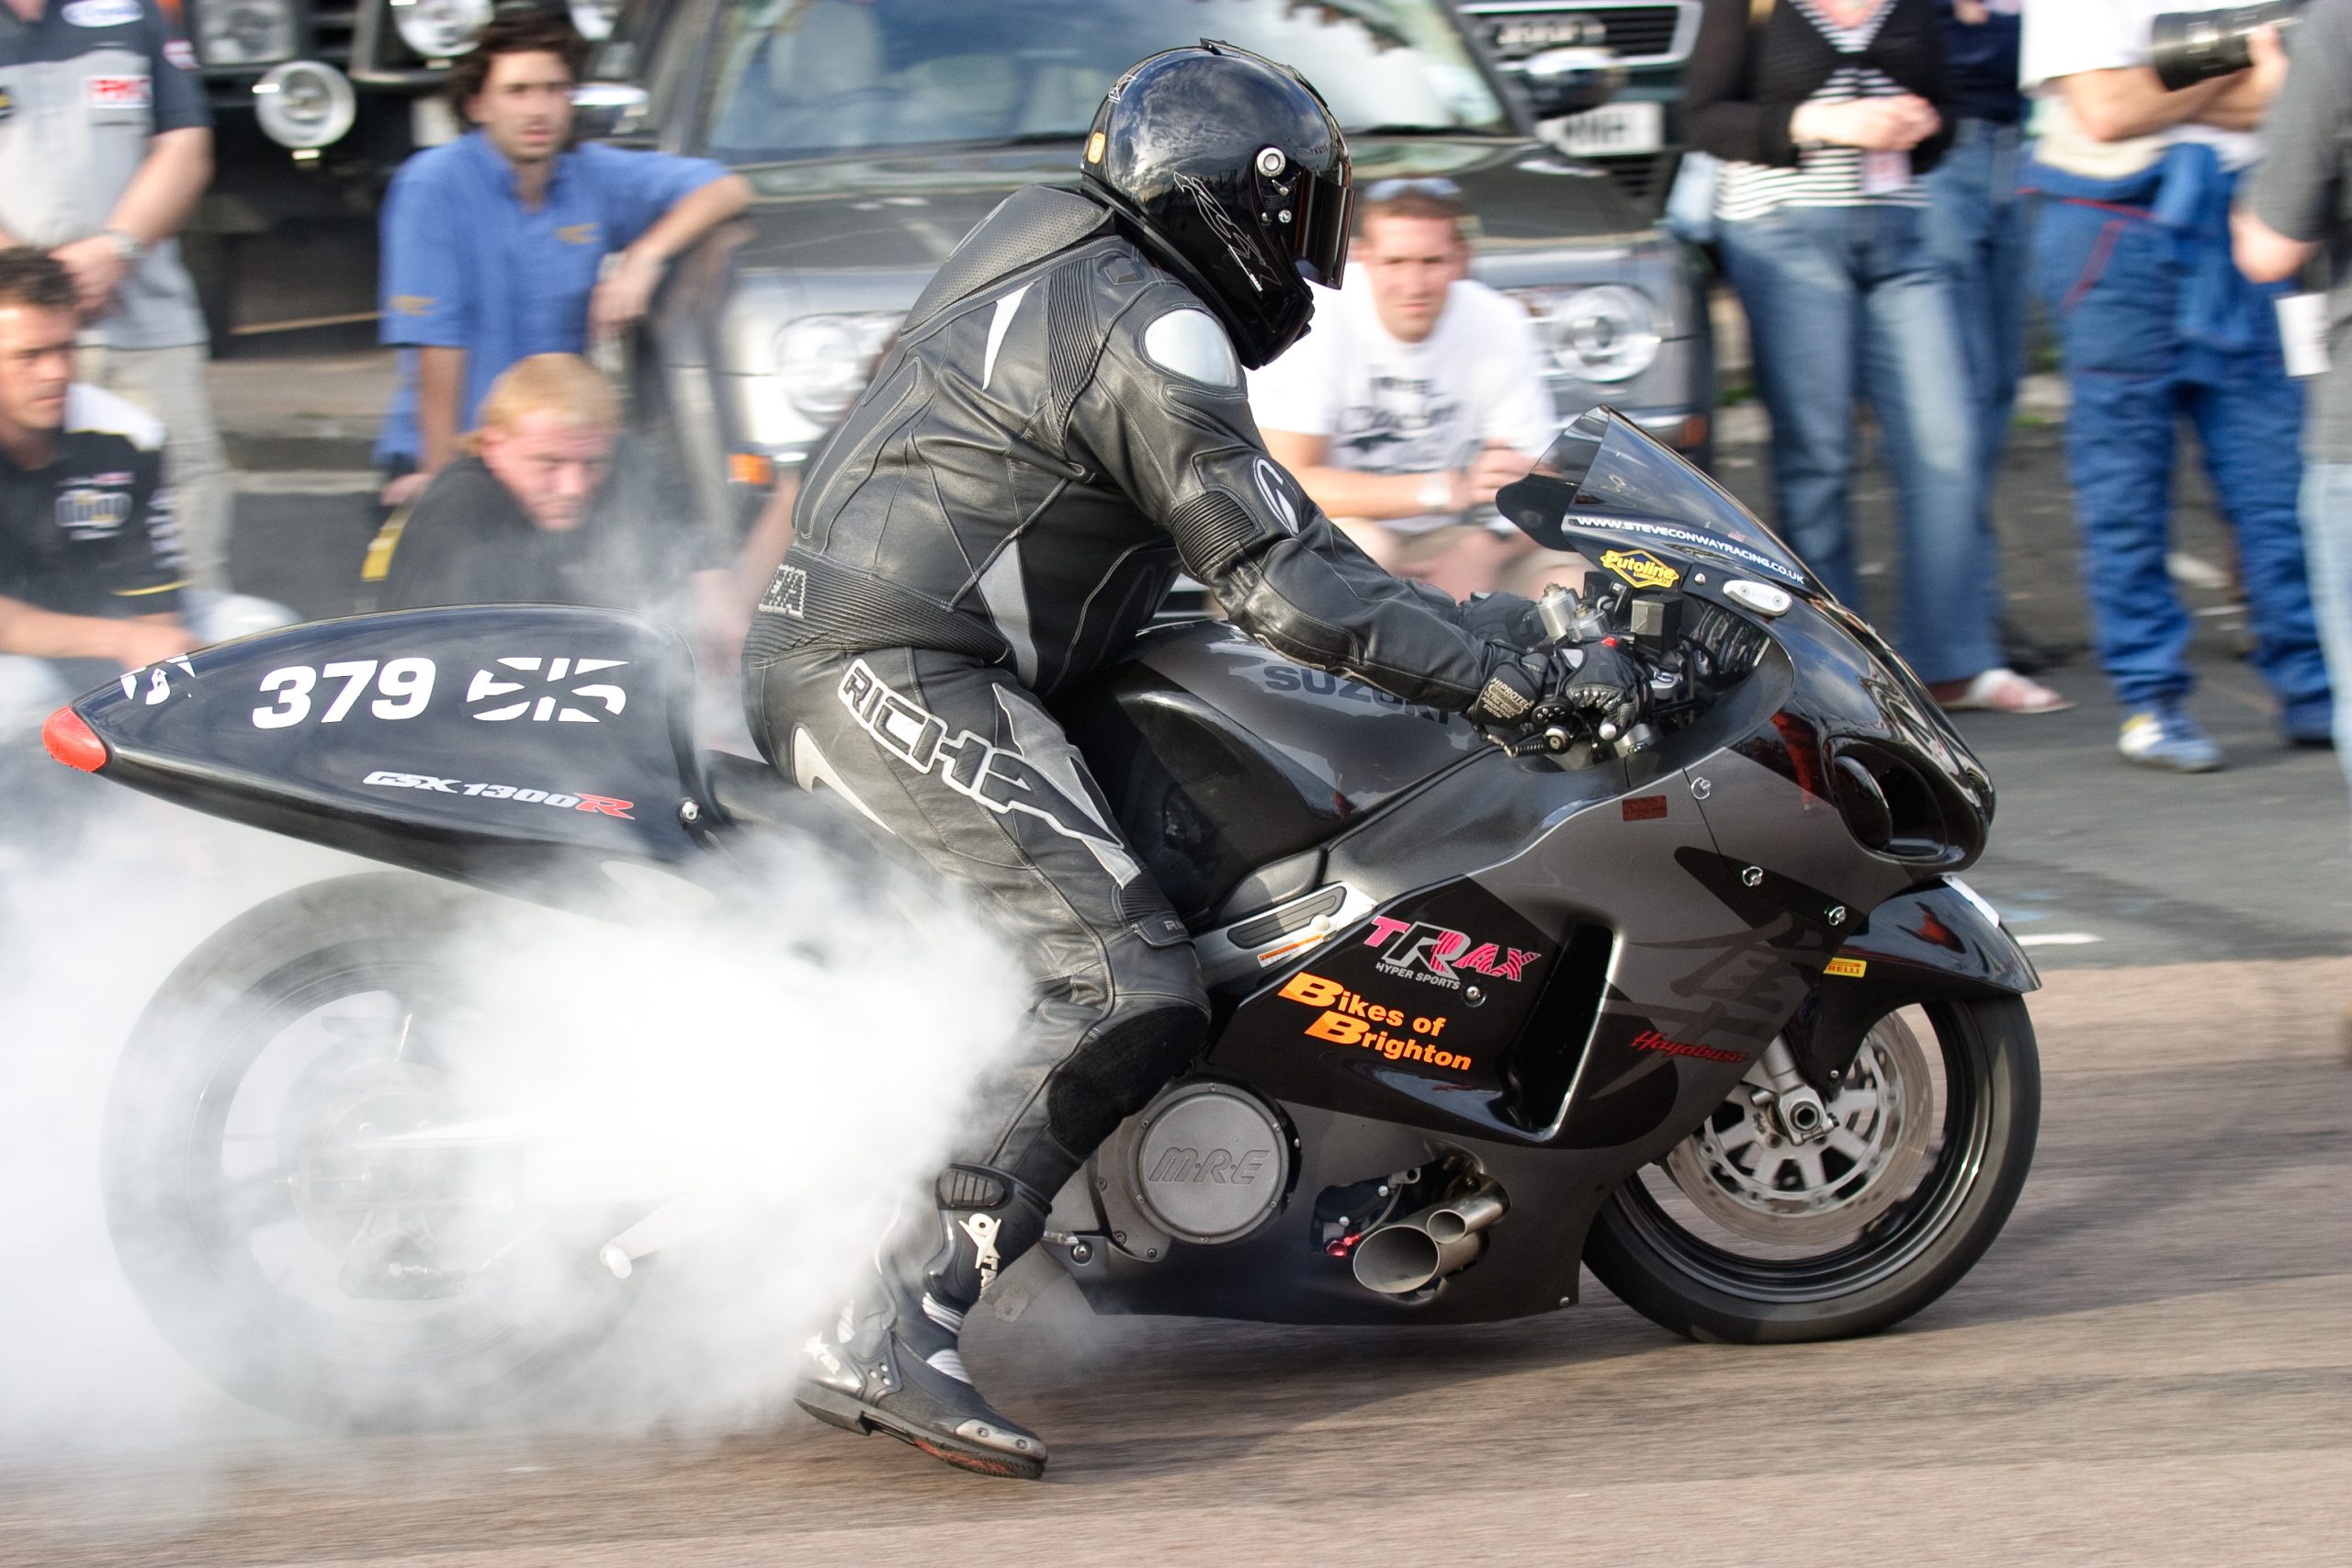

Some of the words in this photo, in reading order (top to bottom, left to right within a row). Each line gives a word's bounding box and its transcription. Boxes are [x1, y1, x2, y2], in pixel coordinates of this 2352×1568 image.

[1577, 517, 1805, 585] WWW.STEVECONWAYRACING.CO.UK
[1603, 551, 1676, 580] Putoline
[252, 658, 436, 729] 379
[363, 771, 462, 794] GSX
[1363, 915, 1542, 982] TRAX
[1376, 962, 1414, 979] HYPER
[1416, 971, 1461, 990] SPORTS
[1278, 972, 1405, 1027] Bikes
[1412, 1016, 1447, 1037] of
[1305, 1010, 1472, 1071] Brighton
[1631, 1030, 1747, 1063] Hayabusa
